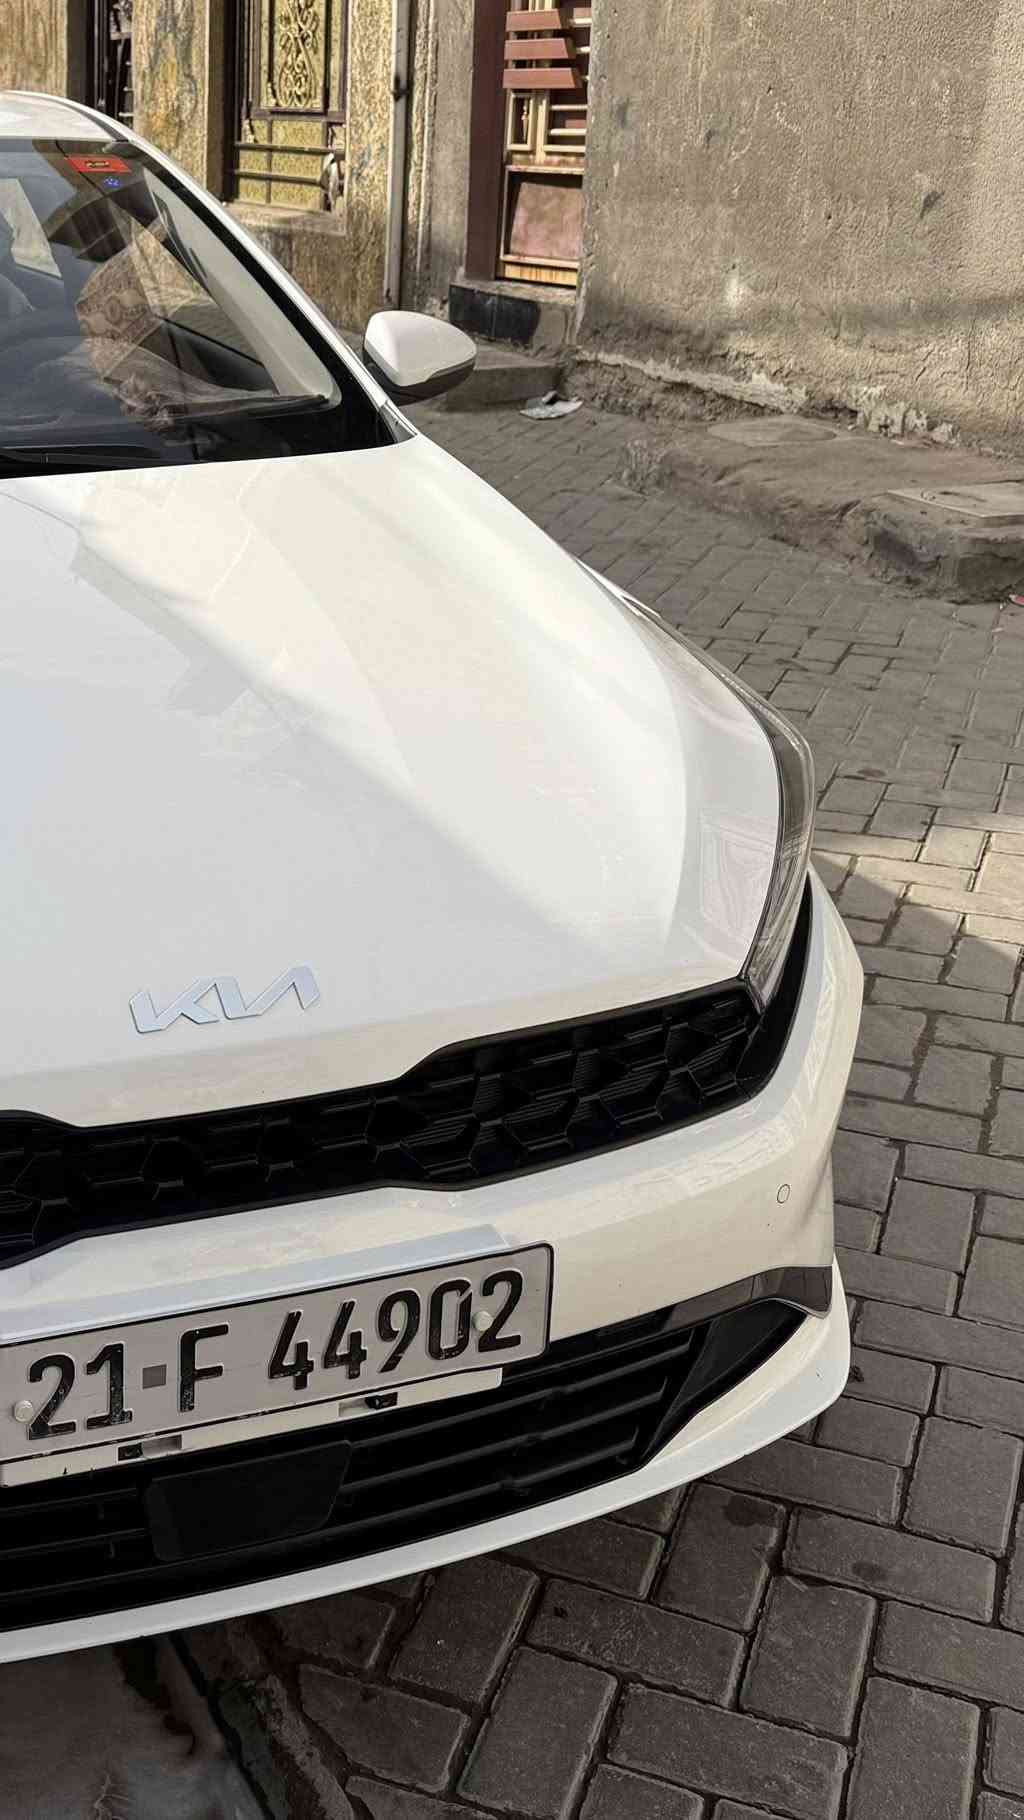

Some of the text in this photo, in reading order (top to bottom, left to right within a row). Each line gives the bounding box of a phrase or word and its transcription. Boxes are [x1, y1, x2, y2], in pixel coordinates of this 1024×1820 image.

[129, 966, 321, 1034] KIA
[28, 1269, 524, 1441] 21 F 44902
